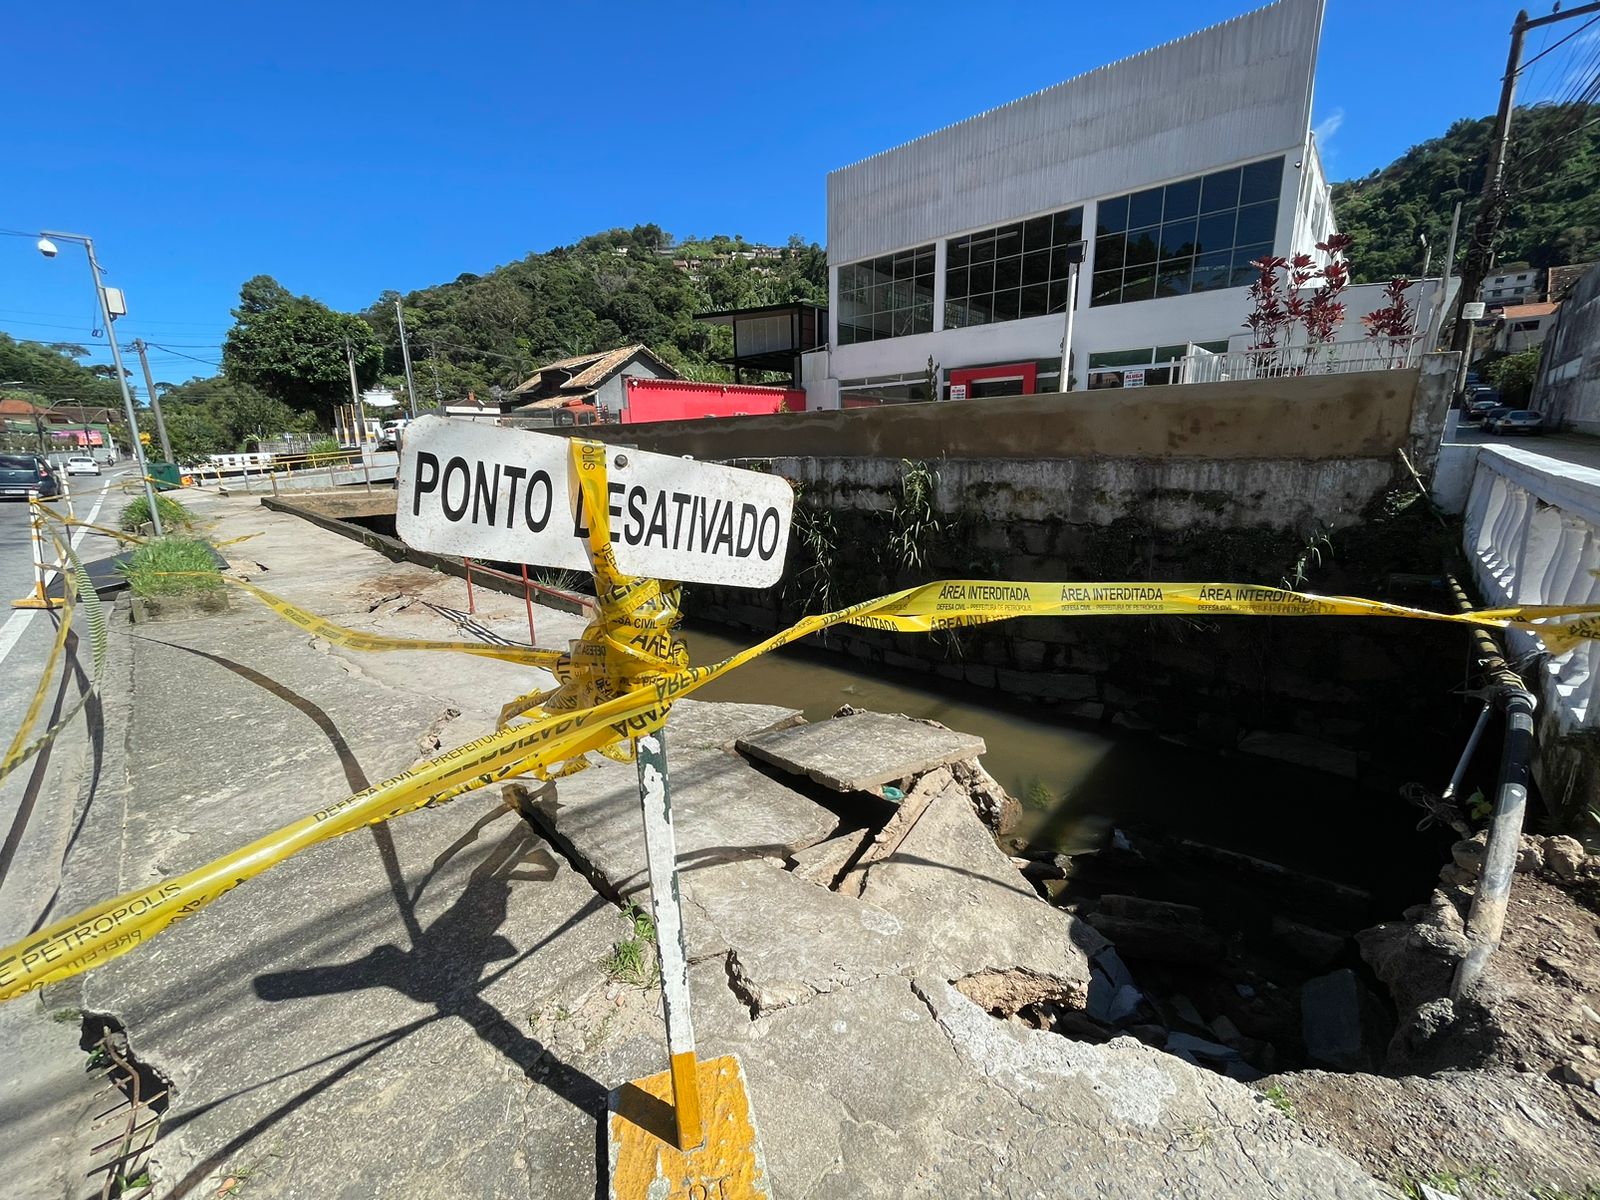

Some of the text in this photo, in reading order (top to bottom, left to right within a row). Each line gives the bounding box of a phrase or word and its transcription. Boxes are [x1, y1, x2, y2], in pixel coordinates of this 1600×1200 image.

[413, 451, 553, 533] PONTO
[939, 582, 1031, 601] ÁREA INTERDITADA
[1061, 585, 1164, 601] ÁREA INTERDITADA
[1199, 585, 1232, 601] ÁREA
[633, 618, 658, 630] CIVIL
[313, 787, 379, 822] DEFESA
[381, 770, 420, 789] CIVIL
[431, 728, 508, 767] PREFEITURA
